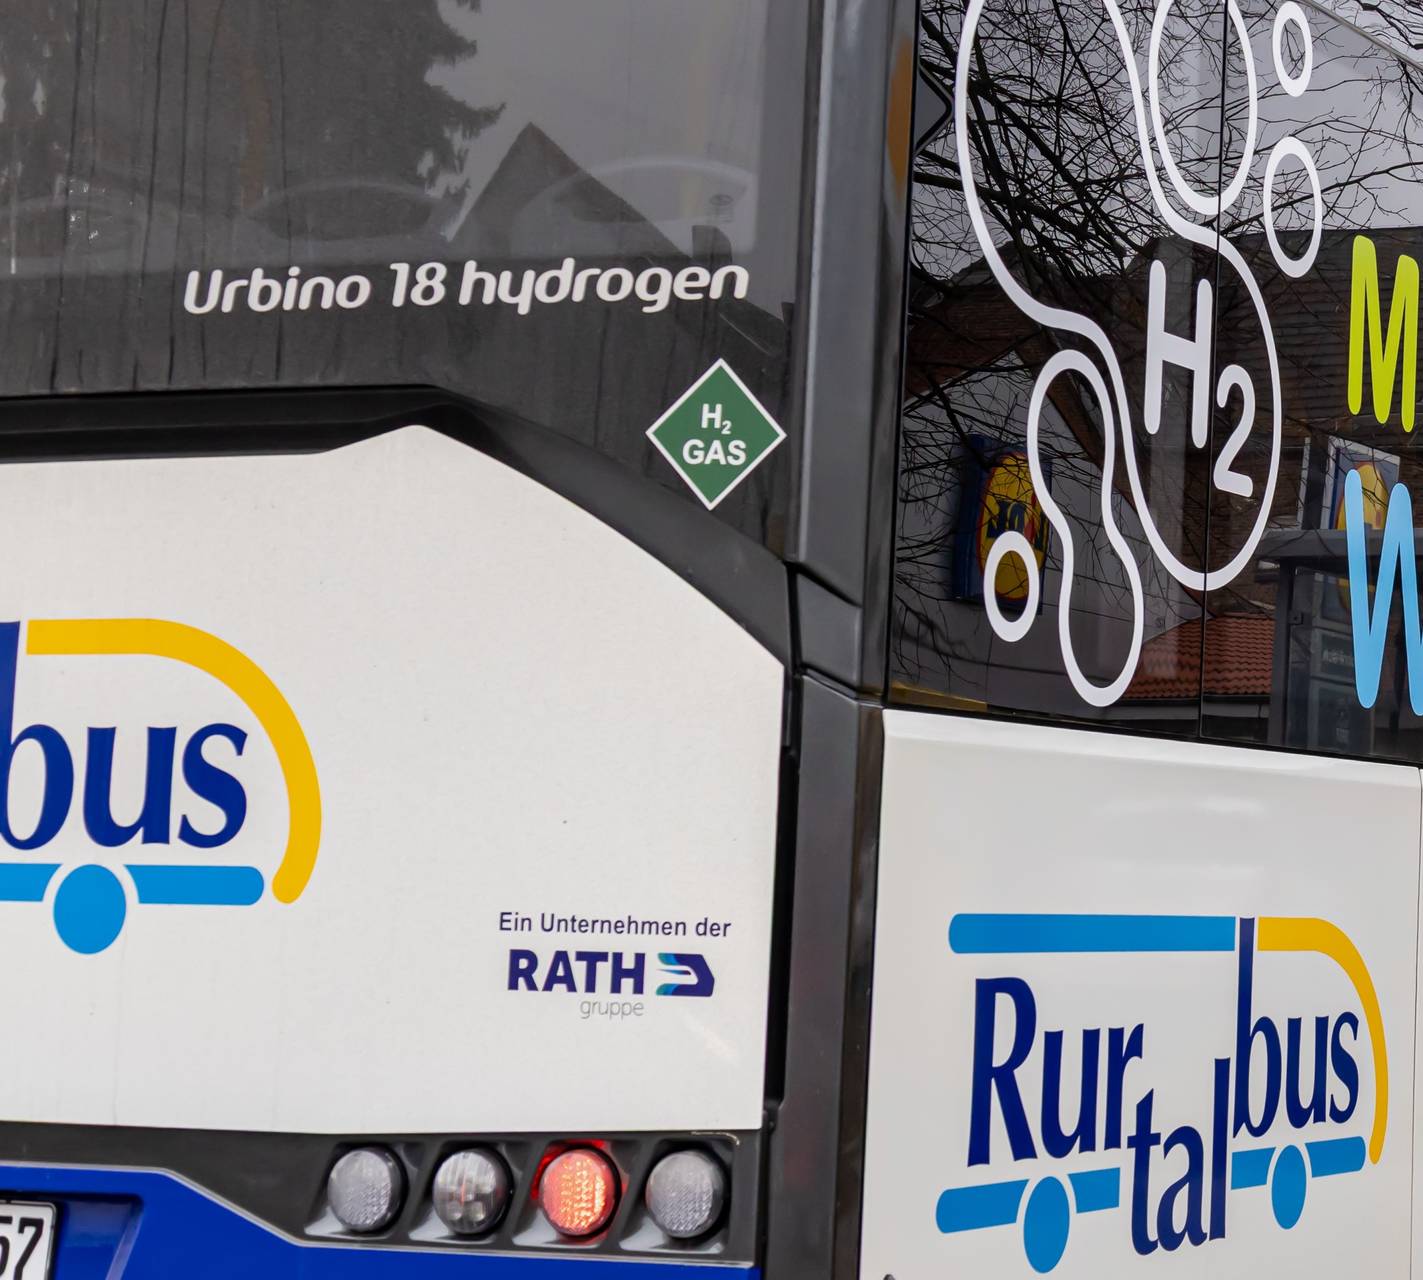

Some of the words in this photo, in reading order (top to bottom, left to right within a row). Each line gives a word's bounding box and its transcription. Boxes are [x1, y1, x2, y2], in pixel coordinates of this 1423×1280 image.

[184, 265, 371, 314] Urbino
[390, 261, 446, 308] 18
[459, 257, 749, 315] hydrogen
[682, 438, 747, 466] GAS
[499, 912, 532, 932] Ein
[540, 912, 687, 936] Unternehmen
[695, 918, 732, 937] der
[507, 948, 646, 995] RATH
[579, 999, 645, 1020] gruppe
